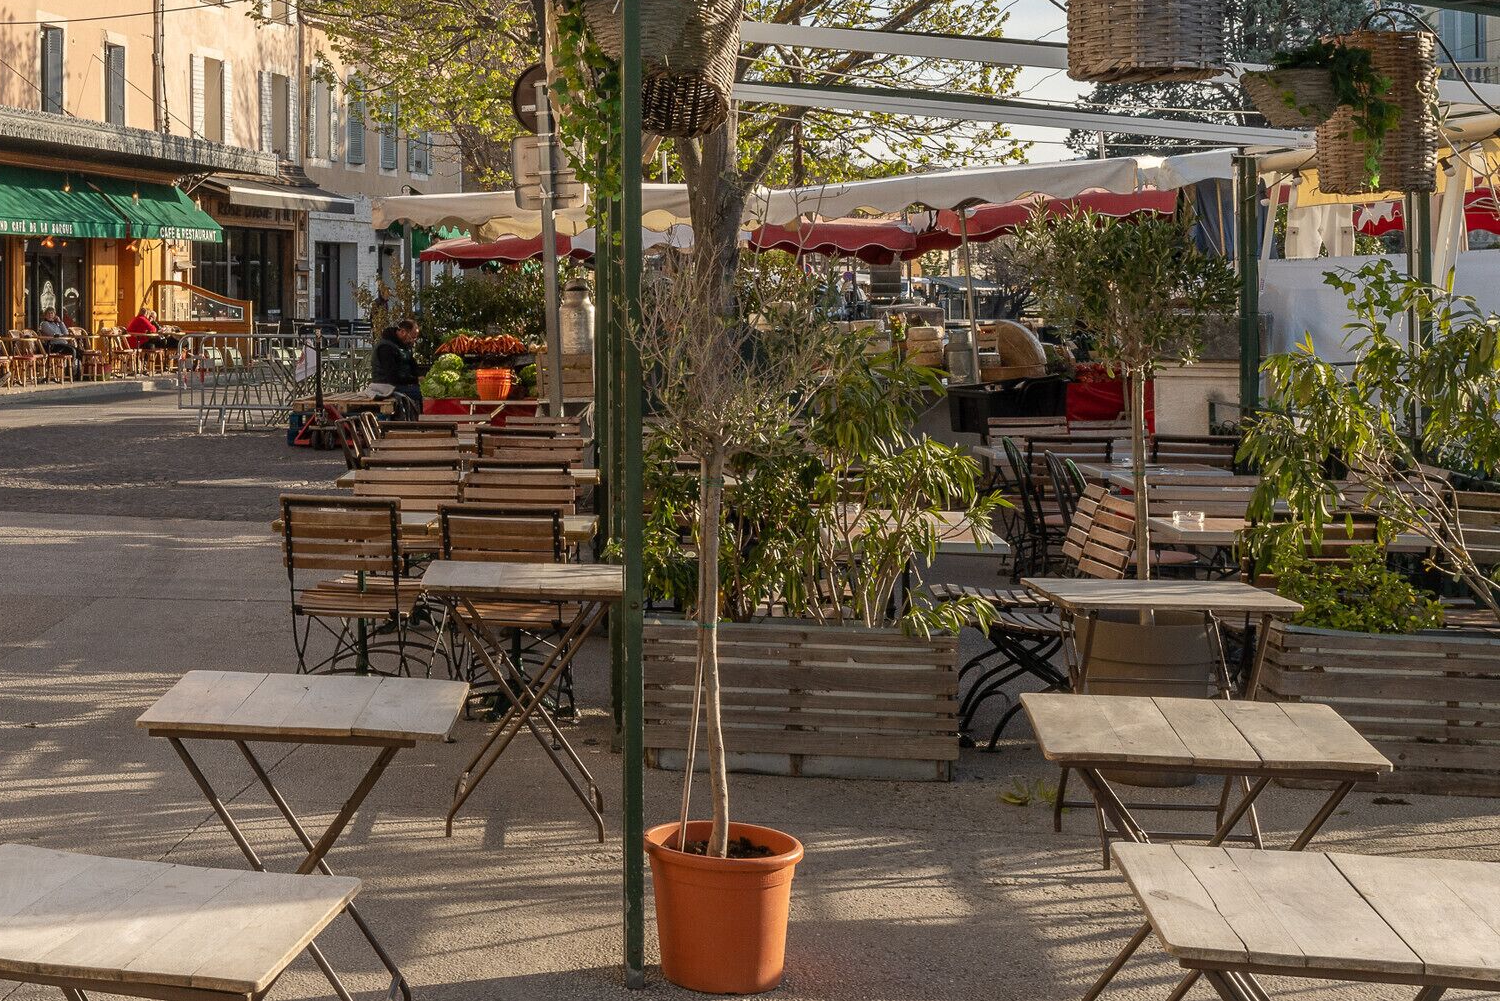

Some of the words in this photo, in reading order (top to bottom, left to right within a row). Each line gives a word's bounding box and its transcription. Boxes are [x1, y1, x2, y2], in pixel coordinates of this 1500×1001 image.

[11, 220, 26, 232] CAFÉ
[29, 222, 37, 233] DE
[40, 222, 48, 233] LA
[51, 223, 73, 234] SORGUE
[159, 226, 175, 239] CAFÉ
[176, 228, 181, 238] &
[181, 228, 216, 241] RESTAURANT
